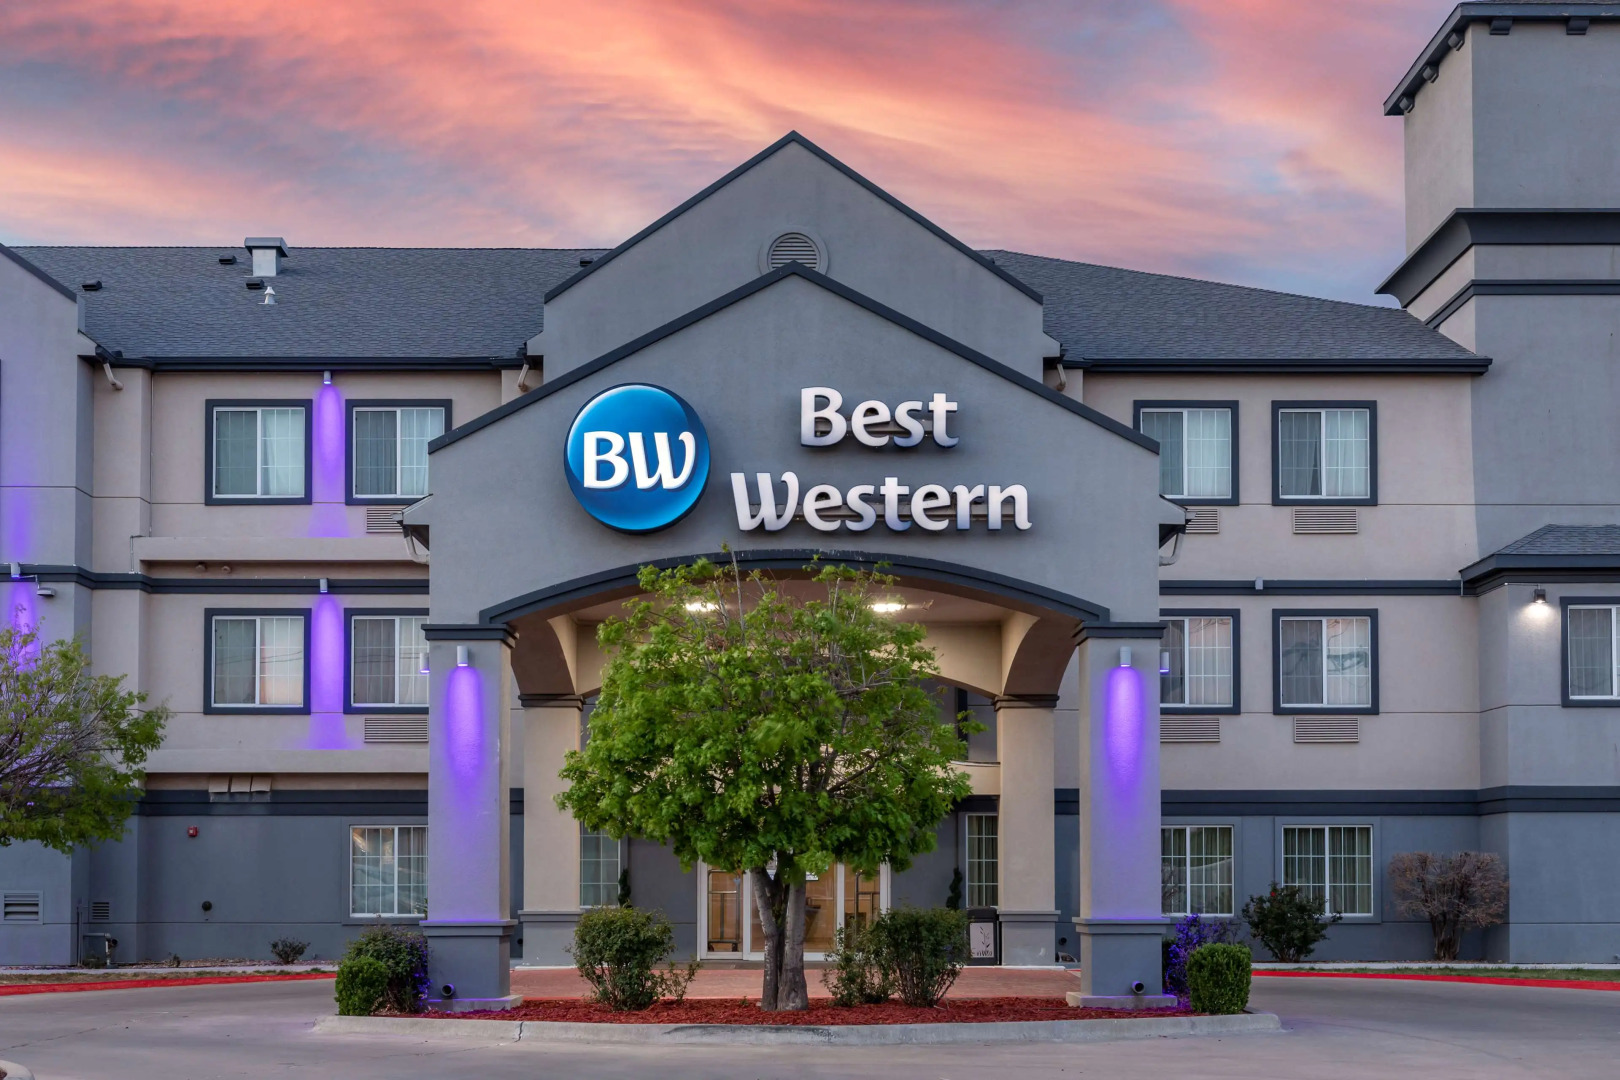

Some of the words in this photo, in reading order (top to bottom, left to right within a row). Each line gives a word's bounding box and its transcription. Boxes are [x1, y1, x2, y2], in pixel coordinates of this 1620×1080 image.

[801, 387, 959, 447] Best
[584, 431, 696, 489] BW
[731, 471, 1032, 531] Western
